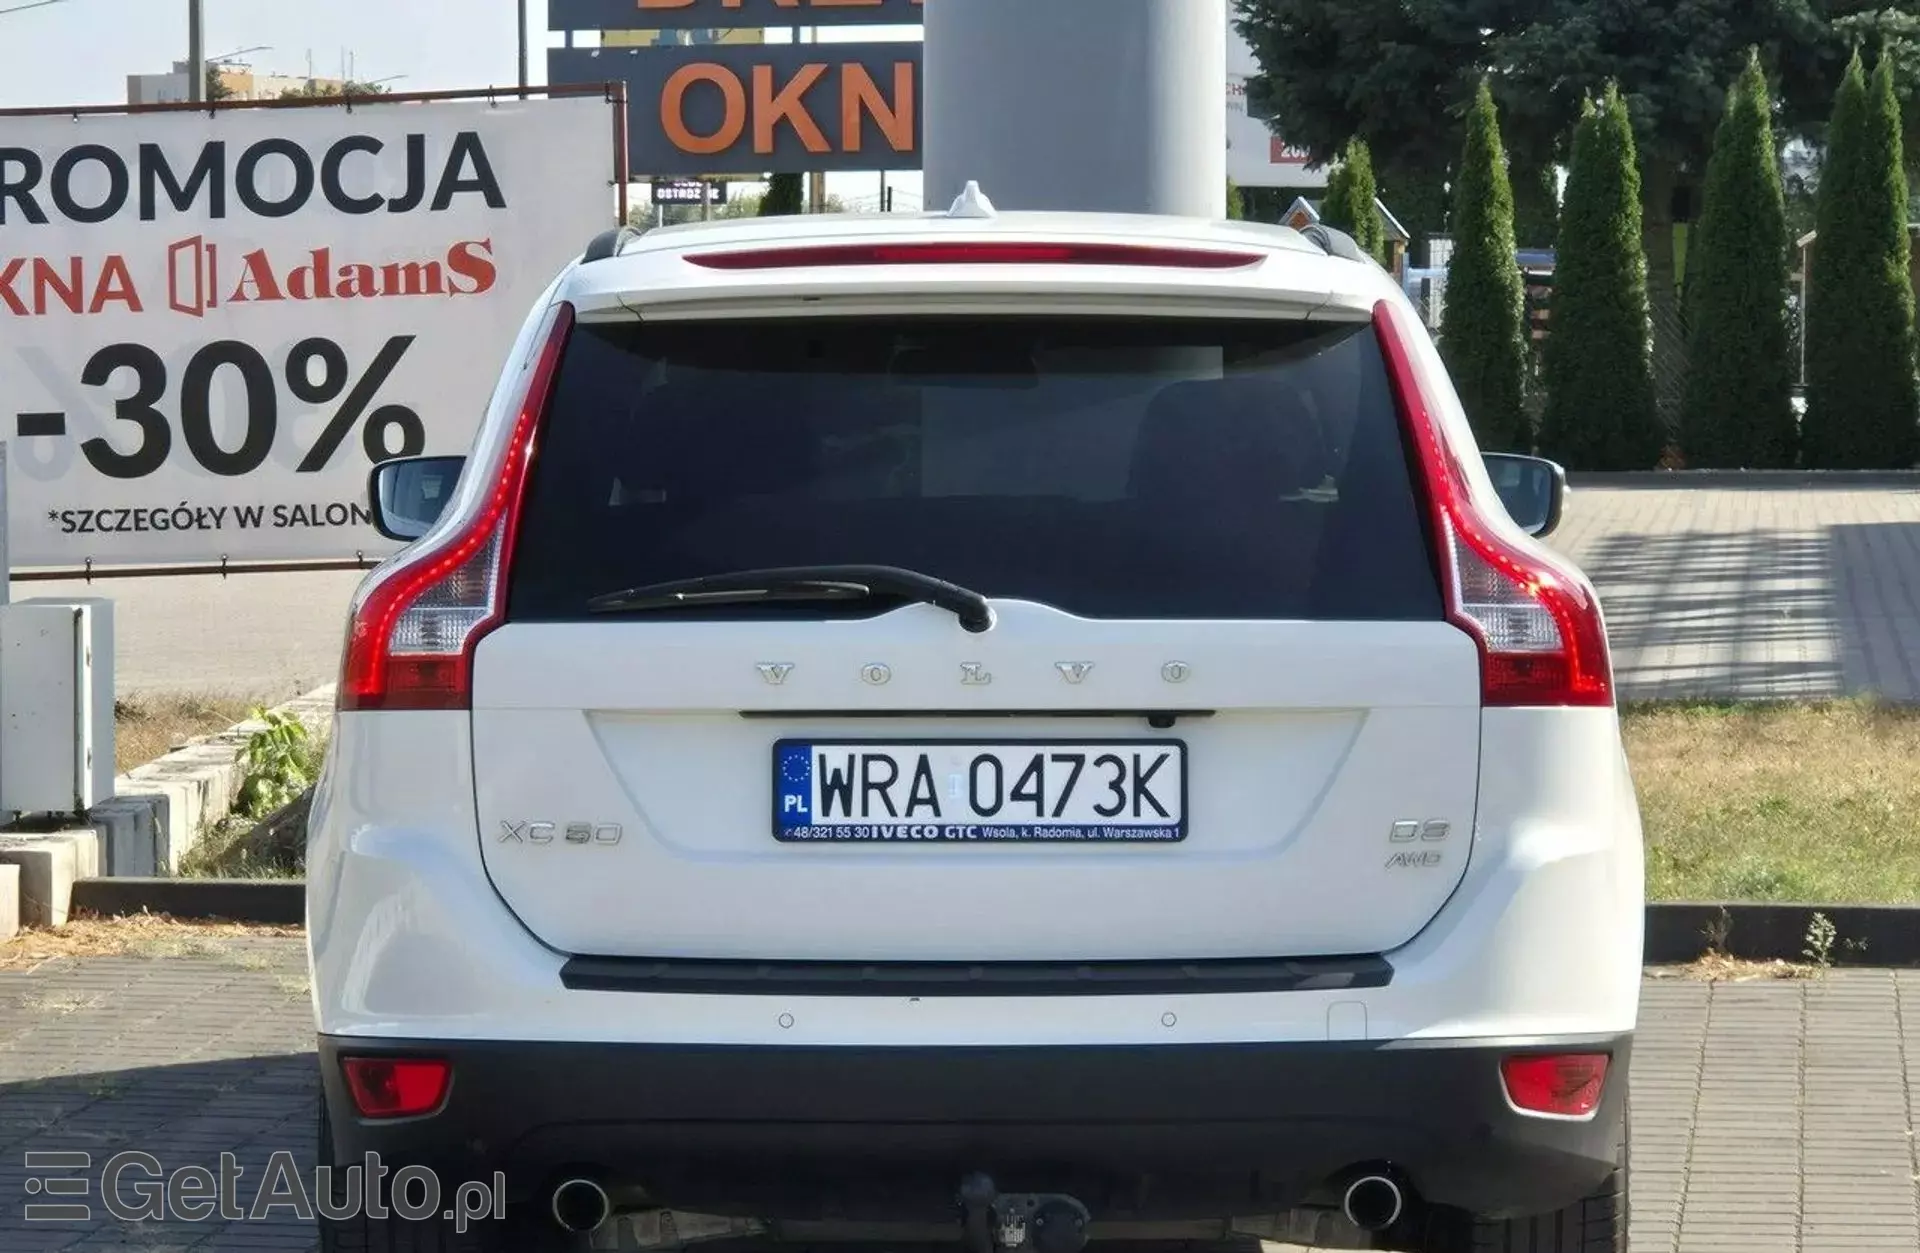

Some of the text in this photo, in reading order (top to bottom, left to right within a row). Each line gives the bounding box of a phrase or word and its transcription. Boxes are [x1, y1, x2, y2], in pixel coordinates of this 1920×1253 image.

[660, 61, 914, 154] OKN
[227, 238, 496, 302] AdamS
[17, 335, 425, 477] -30%
[233, 505, 265, 528] W
[755, 660, 1190, 686] VOLVO
[784, 794, 808, 812] PL
[818, 753, 1171, 818] WRA 0473K
[793, 826, 833, 839] 48/321
[836, 826, 852, 839] 55
[854, 826, 870, 839] 30
[871, 825, 939, 839] IVECO
[1034, 826, 1084, 840] Radomia,
[1087, 826, 1099, 839] ul.
[1103, 826, 1173, 839] Warszawska
